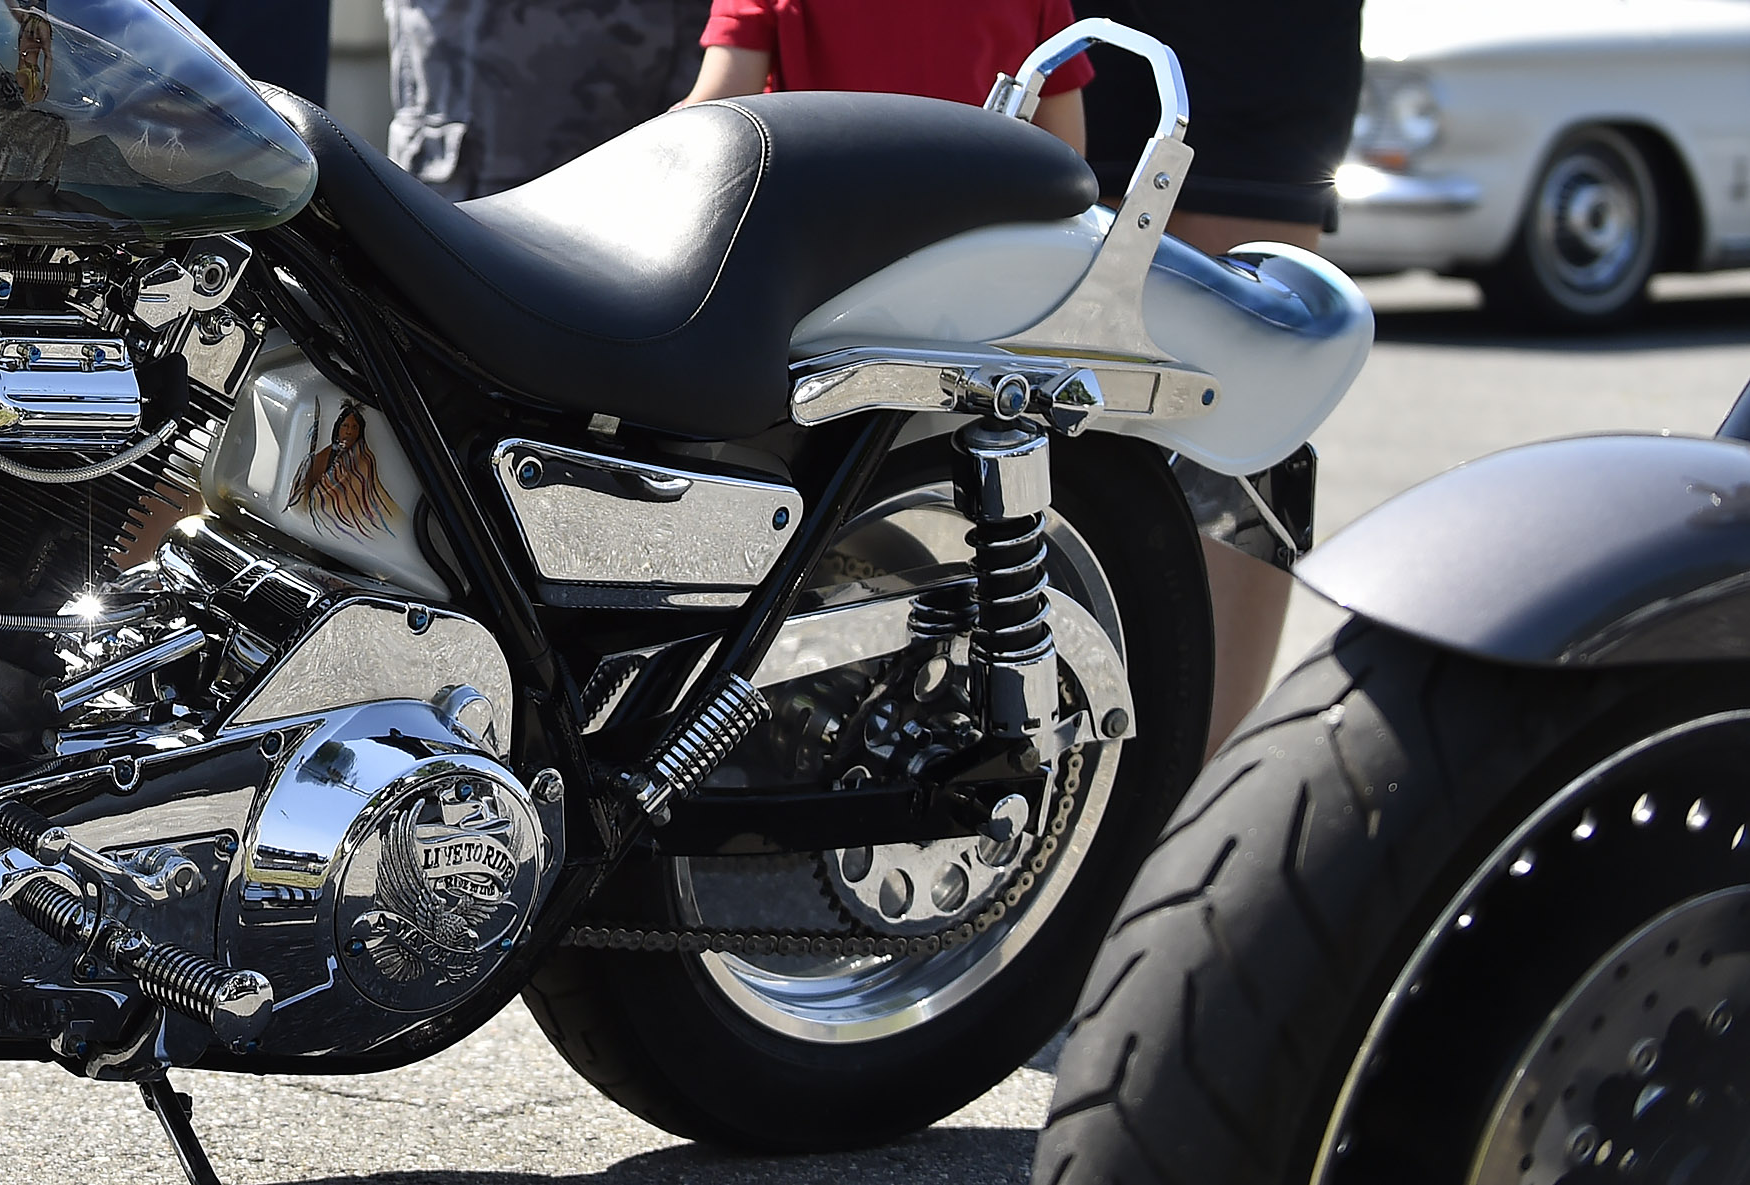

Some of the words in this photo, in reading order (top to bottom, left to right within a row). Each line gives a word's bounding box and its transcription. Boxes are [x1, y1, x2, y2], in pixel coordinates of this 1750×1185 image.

[423, 843, 463, 870] LIVE
[464, 843, 483, 862] TO
[482, 845, 516, 883] RIDE
[371, 913, 391, 933] A
